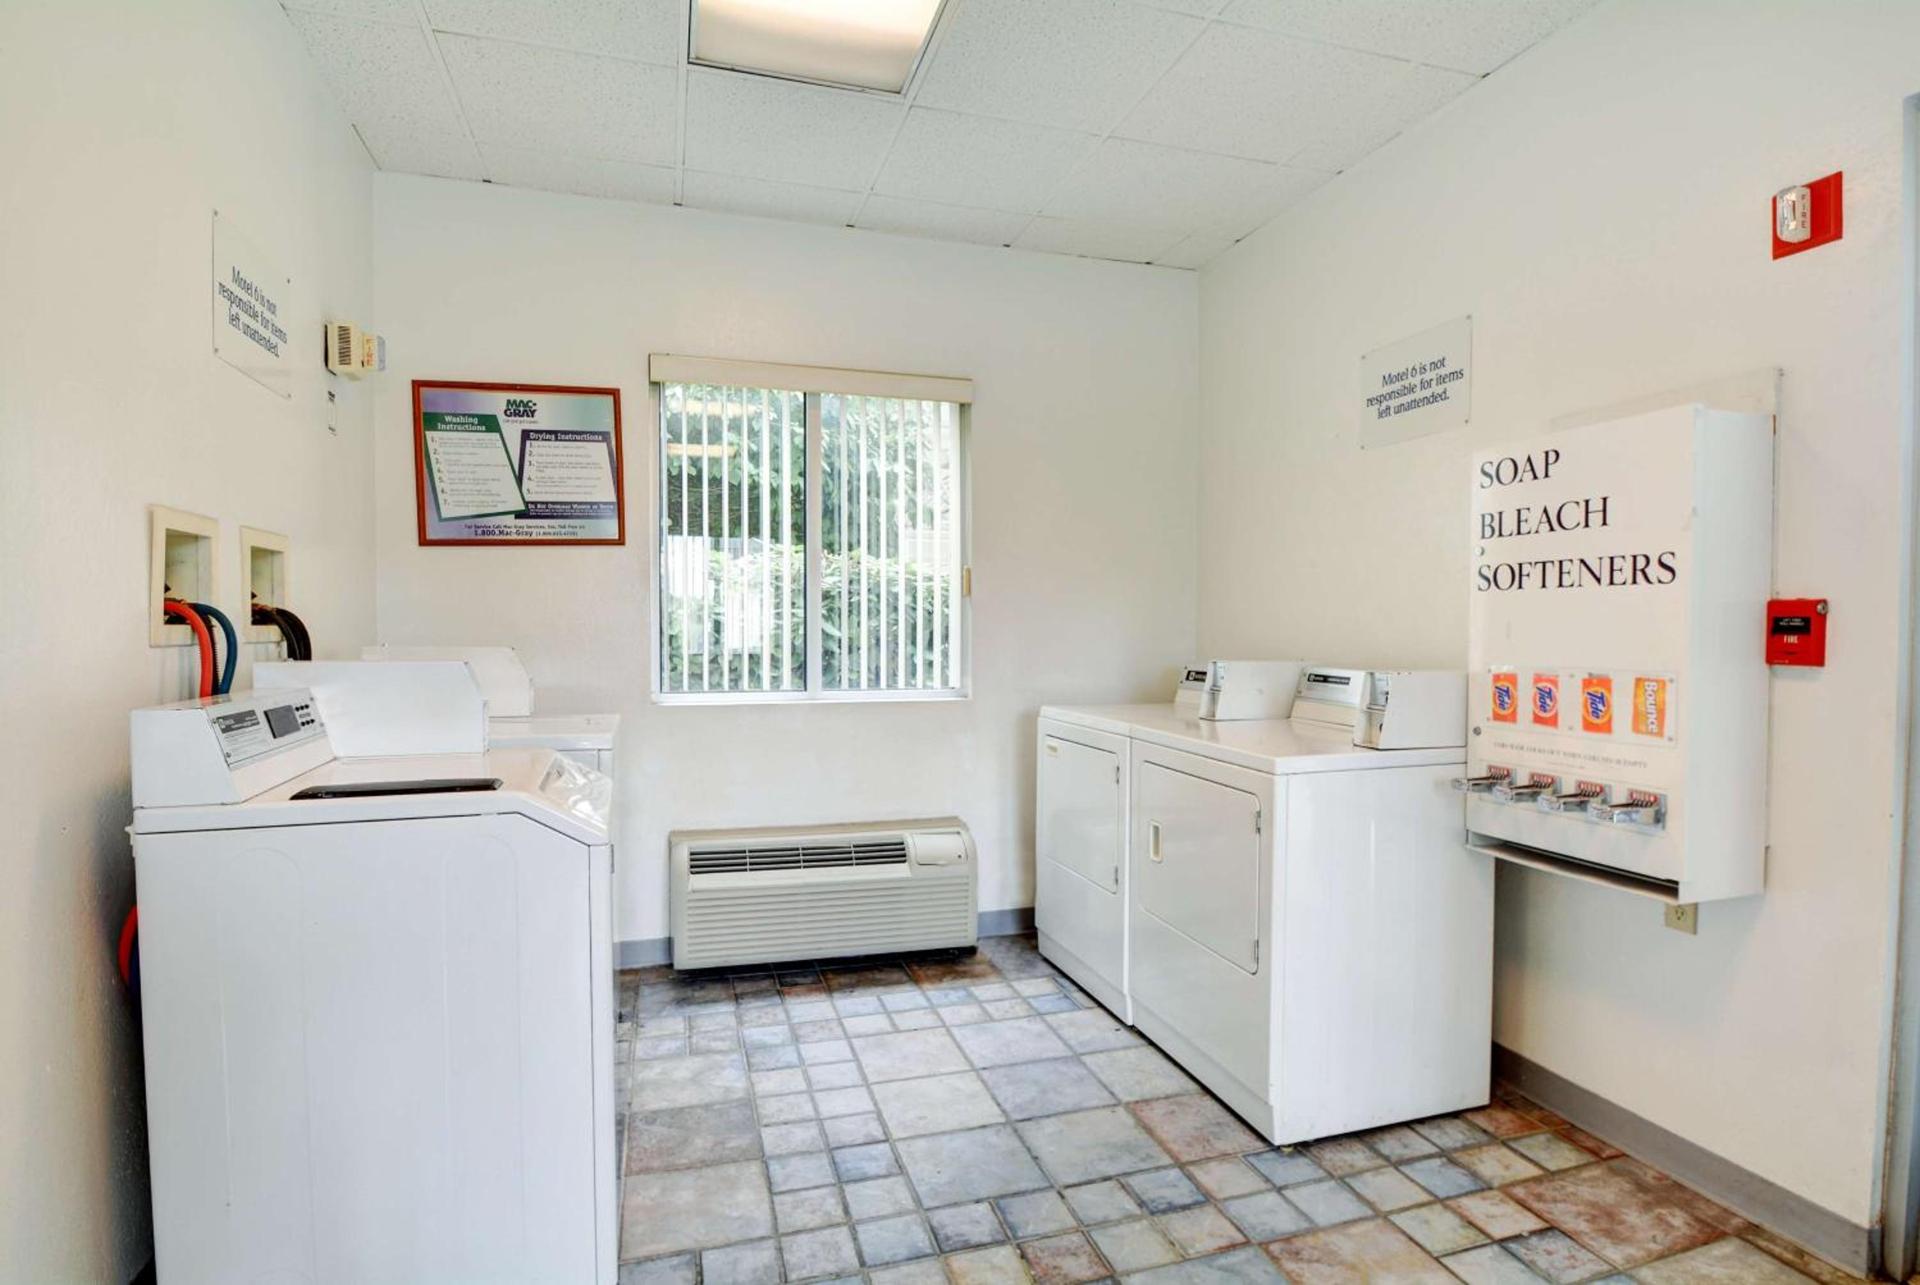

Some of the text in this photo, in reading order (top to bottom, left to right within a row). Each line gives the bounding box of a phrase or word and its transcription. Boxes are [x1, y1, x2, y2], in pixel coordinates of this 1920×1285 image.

[232, 265, 277, 318] Motel 6 is not
[218, 281, 287, 344] responsible for items
[228, 307, 241, 331] left
[1381, 356, 1447, 388] Motel 6 is not
[1366, 368, 1464, 408] responsible for items
[1377, 388, 1450, 419] left unattended.
[437, 423, 486, 431] Instructions
[444, 415, 478, 424] Washing
[504, 408, 537, 418] GRAY
[529, 432, 602, 441] Drying Instructions
[1480, 448, 1560, 489] SOAP
[1480, 496, 1610, 540] BLEACH
[1477, 551, 1677, 592] SOFTENERS
[1494, 685, 1511, 711] Tide
[1536, 685, 1554, 713] Tide
[1586, 690, 1606, 720] Tide
[1645, 680, 1659, 735] Bounce
